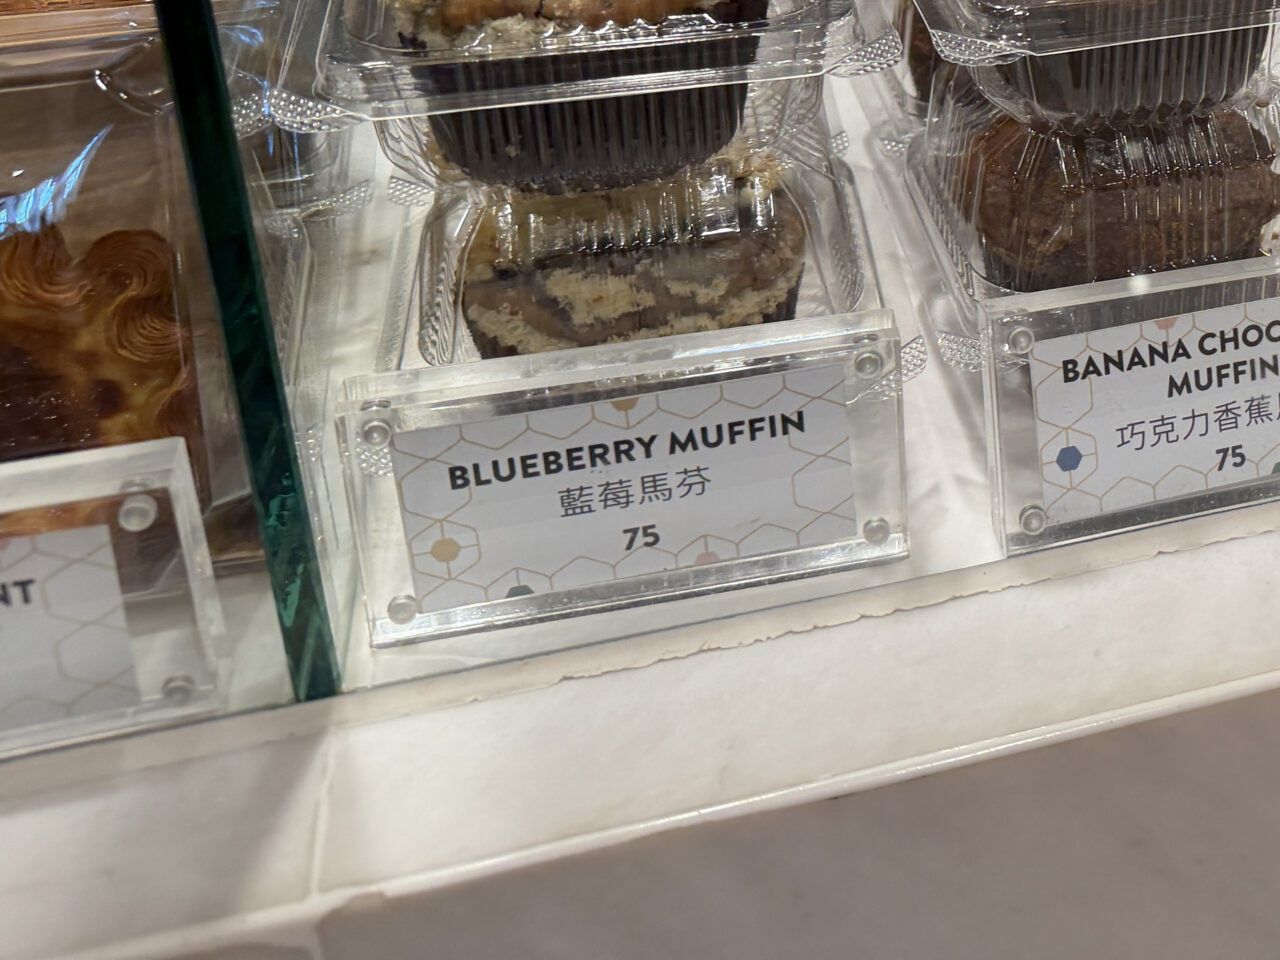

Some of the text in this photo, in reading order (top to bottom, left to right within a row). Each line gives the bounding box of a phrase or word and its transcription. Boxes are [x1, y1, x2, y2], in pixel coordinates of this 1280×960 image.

[1062, 340, 1190, 384] BANANA
[1167, 354, 1280, 398] MUFFIN
[448, 410, 807, 491] BLUEBERRY MUFFIN
[1215, 444, 1247, 471] 75
[558, 465, 712, 518] 藍莓馬芬
[623, 523, 661, 551] 75
